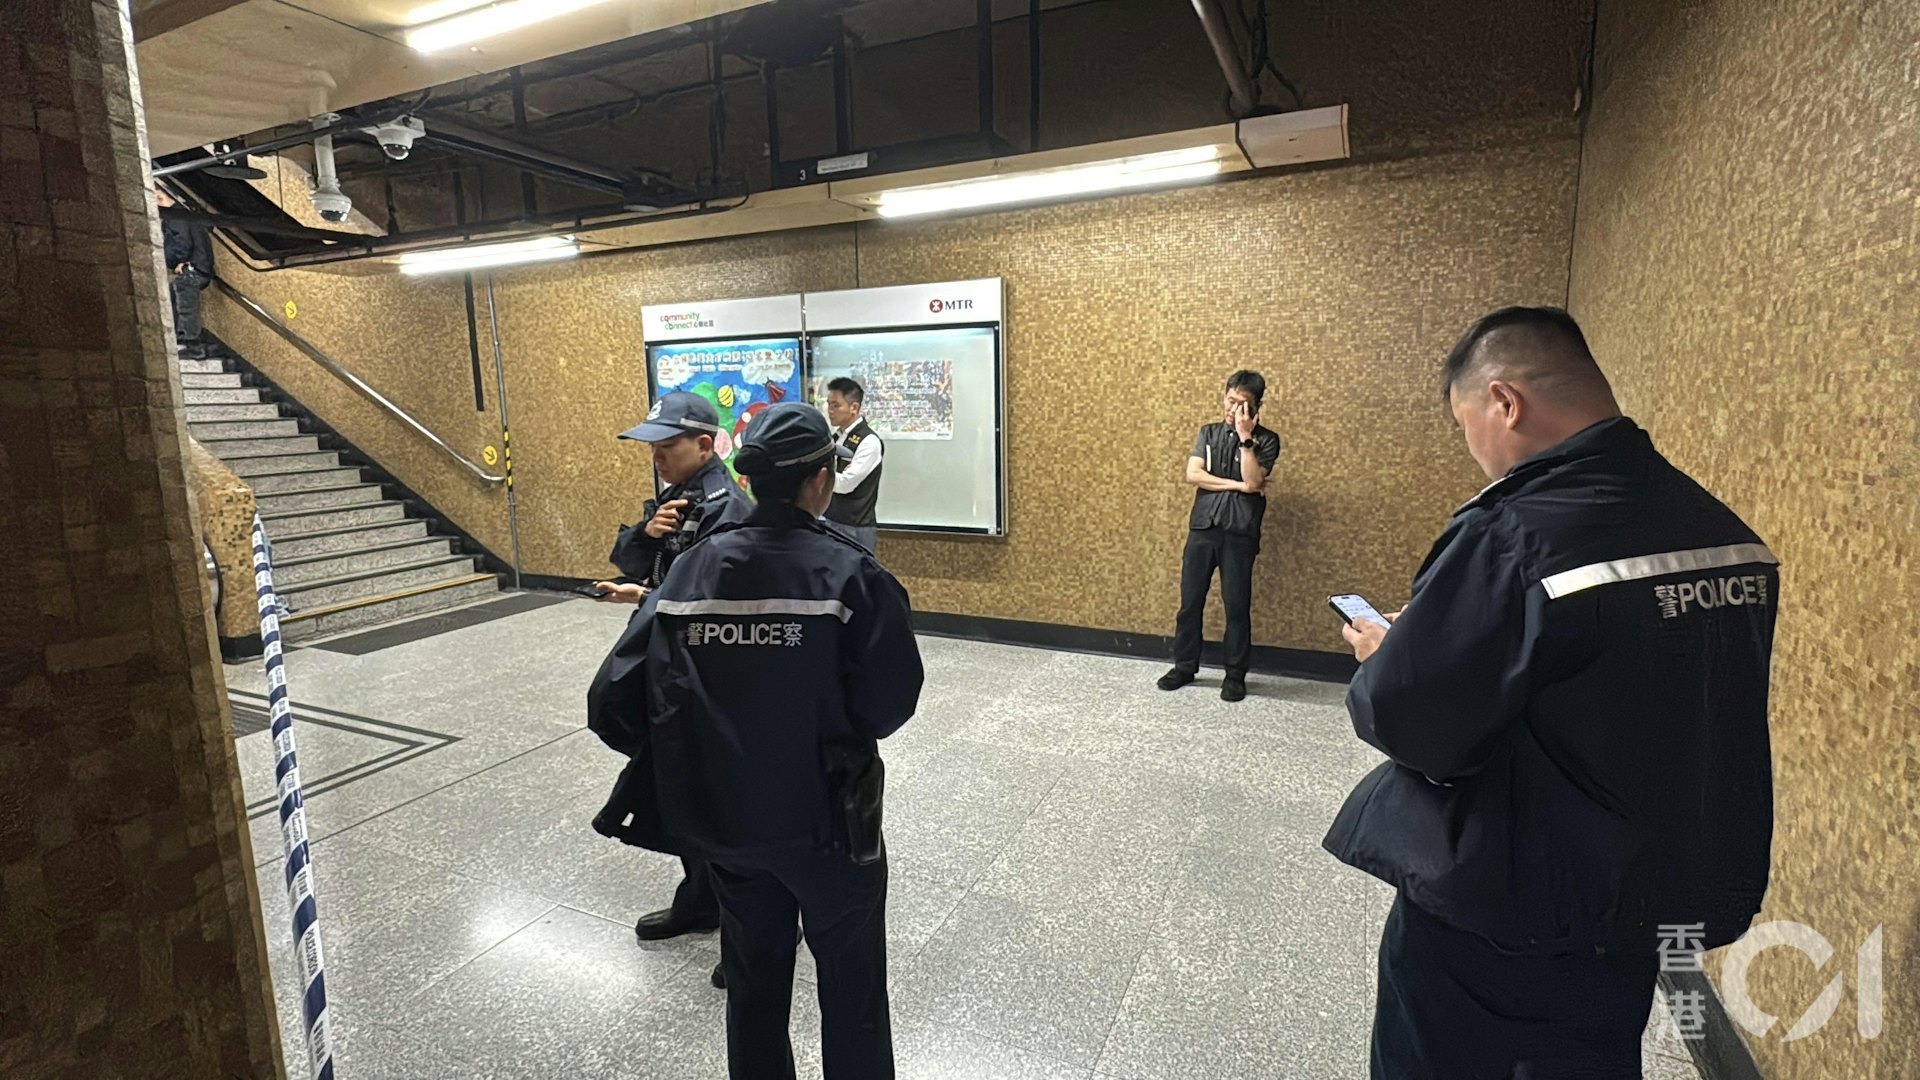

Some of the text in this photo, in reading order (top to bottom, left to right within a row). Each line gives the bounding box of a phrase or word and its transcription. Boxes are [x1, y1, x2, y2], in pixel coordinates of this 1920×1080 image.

[799, 168, 807, 181] 3
[945, 299, 973, 311] MTR
[660, 311, 700, 322] community
[664, 321, 693, 331] connect
